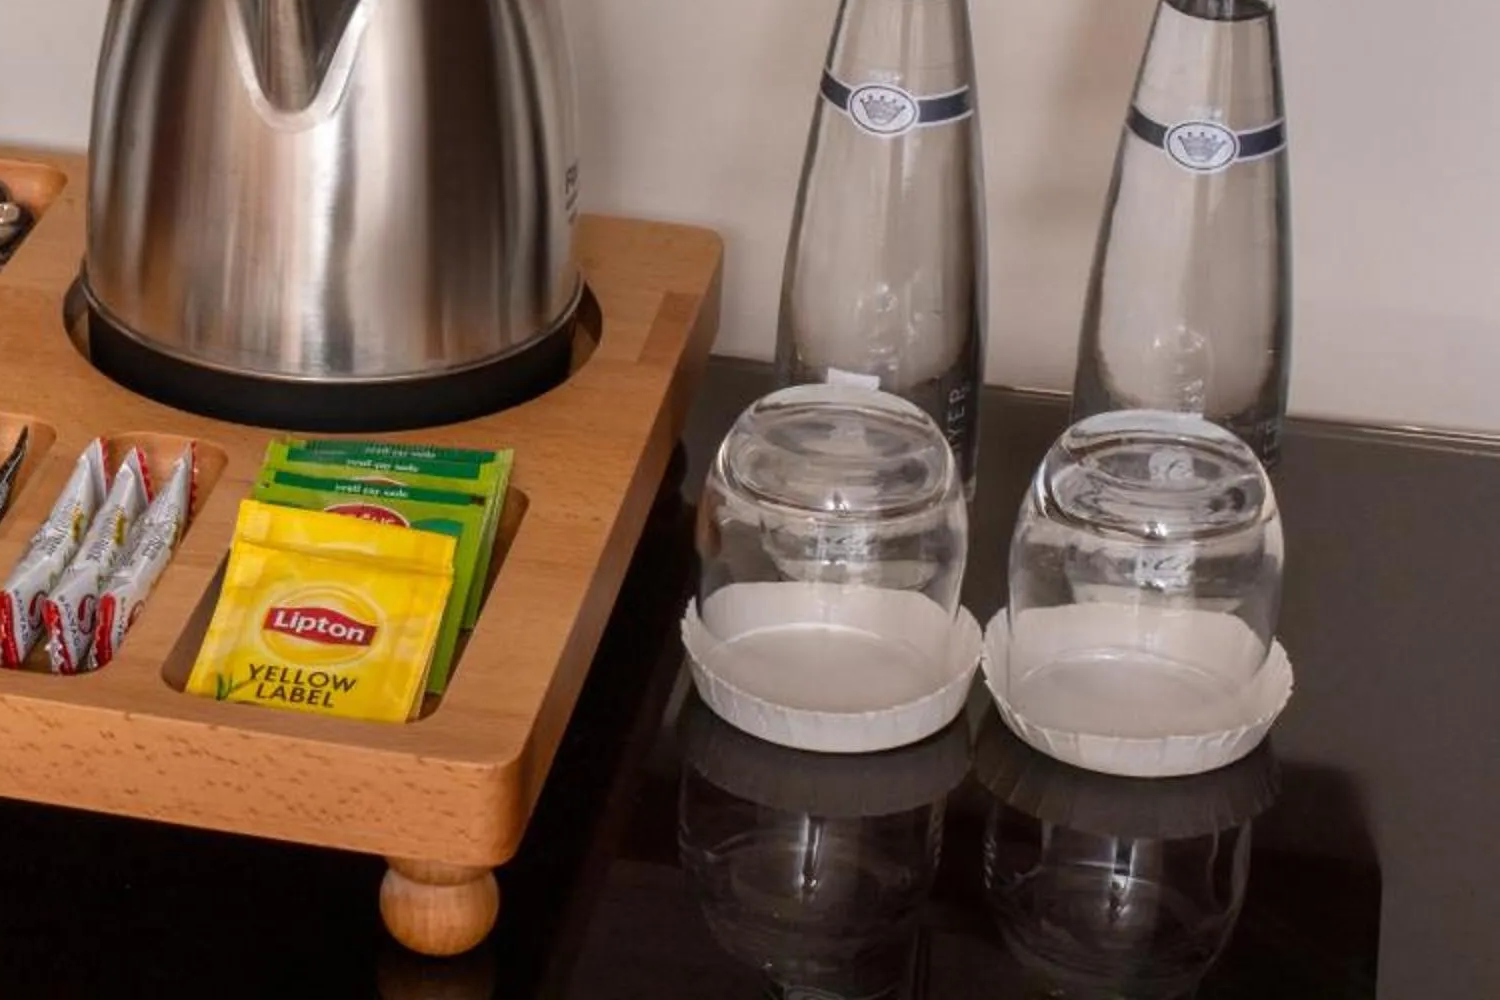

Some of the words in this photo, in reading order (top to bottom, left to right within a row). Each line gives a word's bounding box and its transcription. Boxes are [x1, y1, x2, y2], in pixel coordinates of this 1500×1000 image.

[272, 610, 366, 642] Lipton
[249, 663, 358, 693] YELLOW
[255, 682, 335, 709] LABEL
